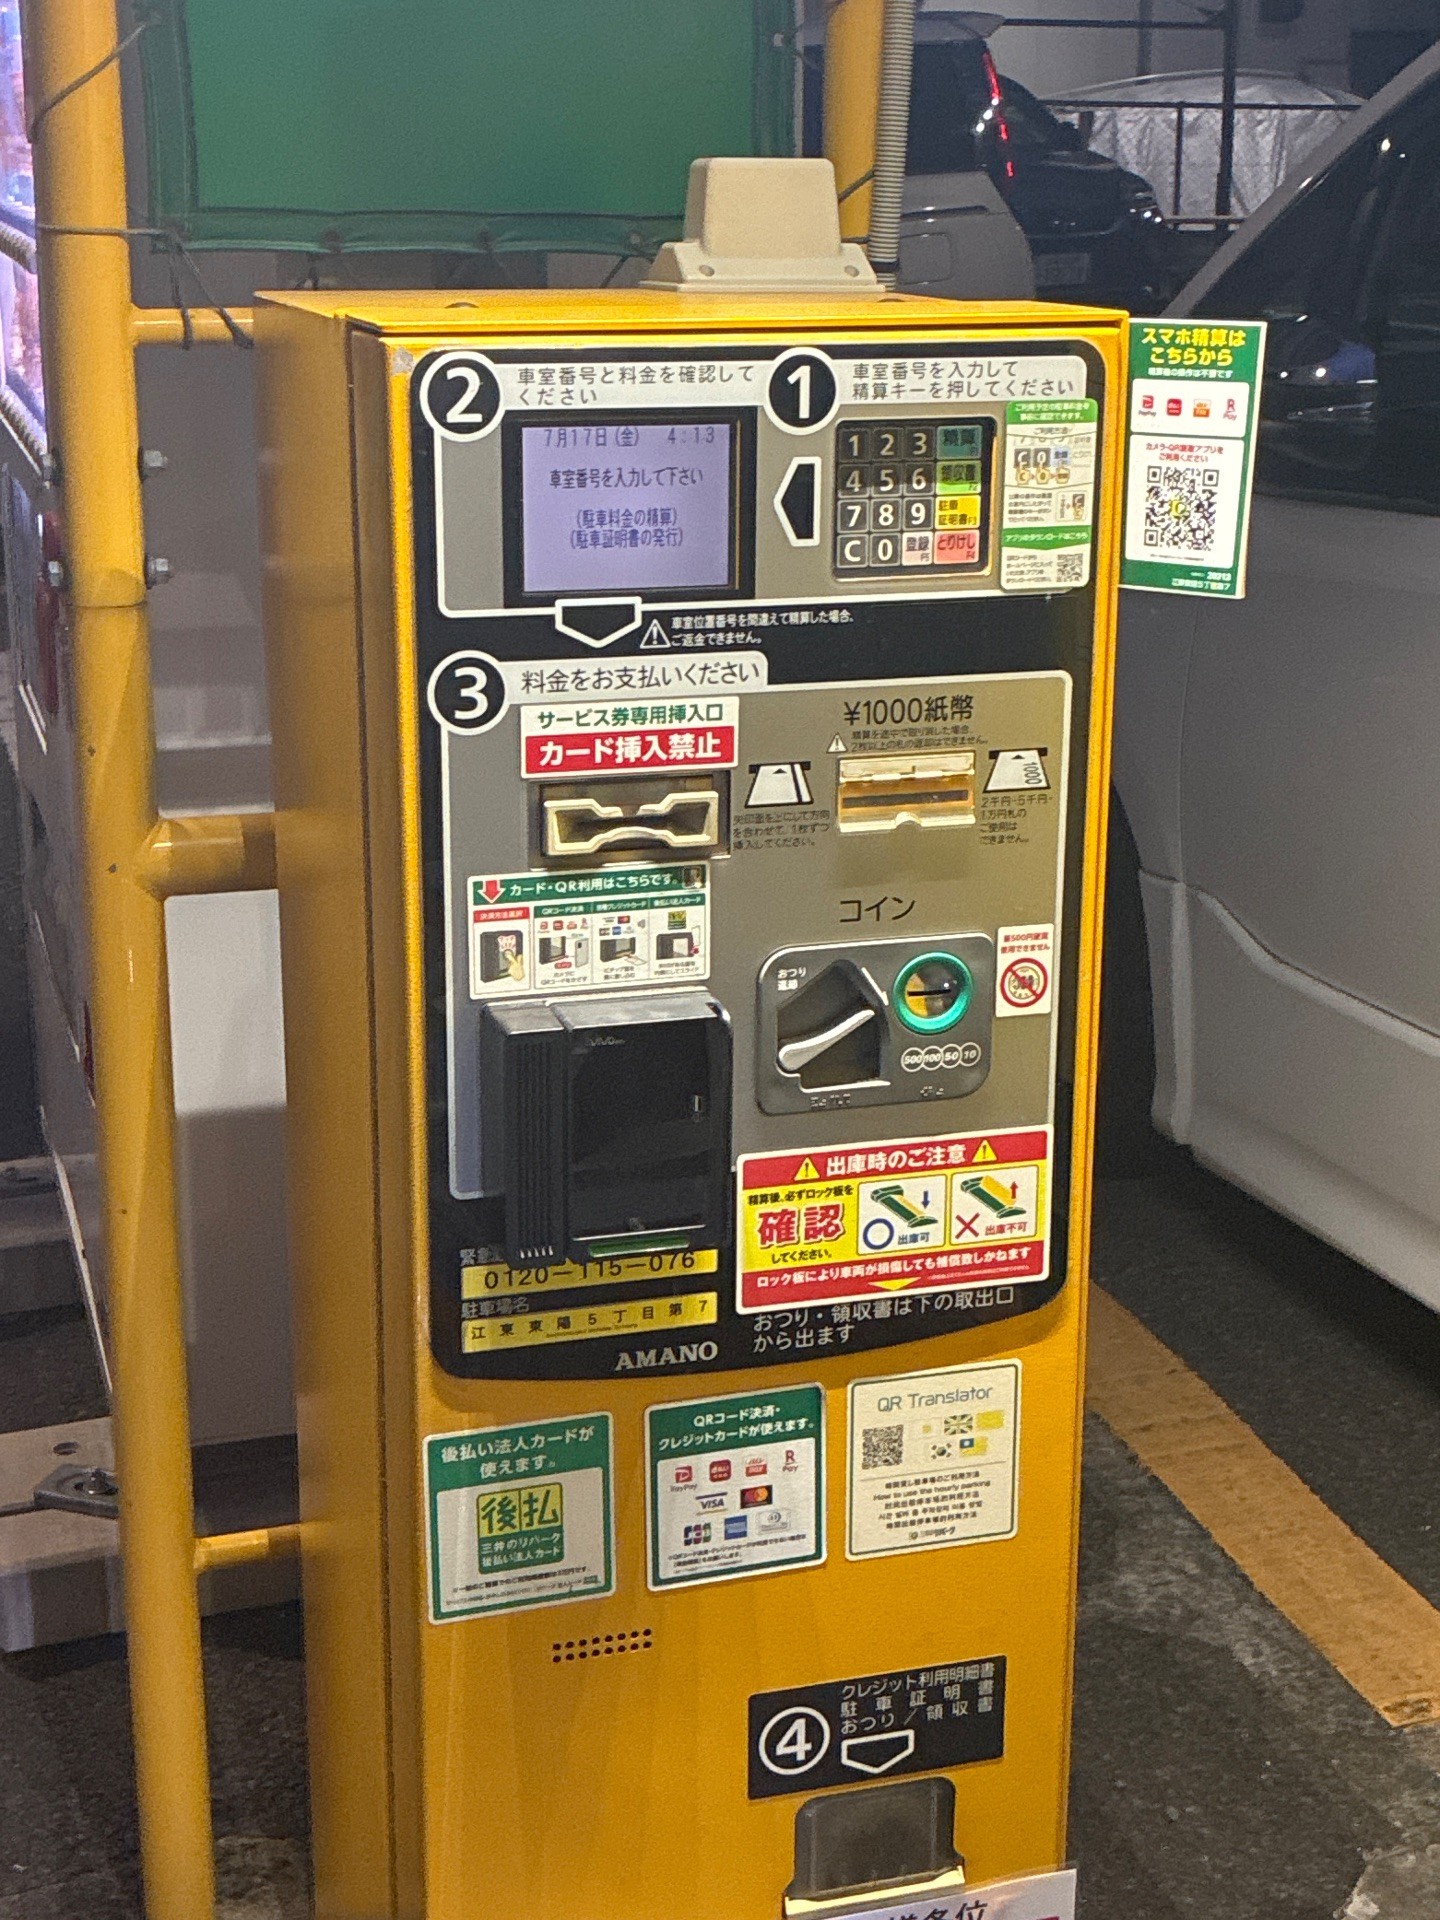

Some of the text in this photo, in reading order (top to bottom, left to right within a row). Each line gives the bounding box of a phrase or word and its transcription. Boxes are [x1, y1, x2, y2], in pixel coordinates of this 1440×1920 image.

[1141, 328, 1246, 347] スマホ精算は
[1150, 347, 1233, 366] こちらから
[517, 365, 755, 386] 車室番号と料金を確認して
[853, 360, 1019, 381] 車室番号を入力して
[446, 367, 483, 423] 2
[518, 388, 598, 406] ください
[786, 364, 811, 419] 1
[852, 379, 1074, 400] 精算キーを押してください
[667, 426, 716, 445] 4:13
[849, 435, 859, 456] 1
[880, 434, 895, 455] 2
[913, 433, 927, 455] 3
[549, 467, 704, 489] 車室番号を入力して下さい
[846, 470, 862, 492] 4
[880, 469, 894, 491] 5
[912, 468, 927, 490] 6
[847, 505, 862, 527] 7
[879, 504, 894, 525] 8
[911, 503, 926, 525] 9
[844, 540, 861, 562] C
[877, 538, 893, 561] 0
[906, 536, 930, 552] 登録
[937, 534, 976, 550] とりけし
[521, 662, 760, 692] 料金をお支払いください
[453, 667, 488, 719] 3
[538, 704, 724, 728] サービス券専用挿入口
[540, 732, 721, 766] カード挿入禁止
[1023, 762, 1042, 784] 1000
[839, 896, 915, 922] コイン
[777, 967, 807, 979] おつり
[905, 1055, 922, 1065] 500
[944, 1051, 958, 1061] 50
[826, 1144, 967, 1177] 出庫時のご注意
[758, 1203, 844, 1247] 確認
[985, 1221, 1027, 1237] 出庫不可
[898, 1231, 930, 1245] 出庫可
[771, 1250, 833, 1265] してください。
[753, 1286, 1014, 1332] おつり・領収書は下の取出口
[753, 1324, 855, 1353] から出ます
[615, 1341, 718, 1371] AMANO
[878, 1387, 993, 1412] QR Translator
[441, 1425, 594, 1463] 後払い法人カードが
[659, 1417, 815, 1451] クレジットカードが使えます。
[480, 1454, 556, 1479] 使えます。
[481, 1489, 559, 1534] 後払
[700, 1500, 725, 1510] VISA
[684, 1522, 711, 1546] JCB
[842, 1662, 995, 1701] クレジット利用明細書
